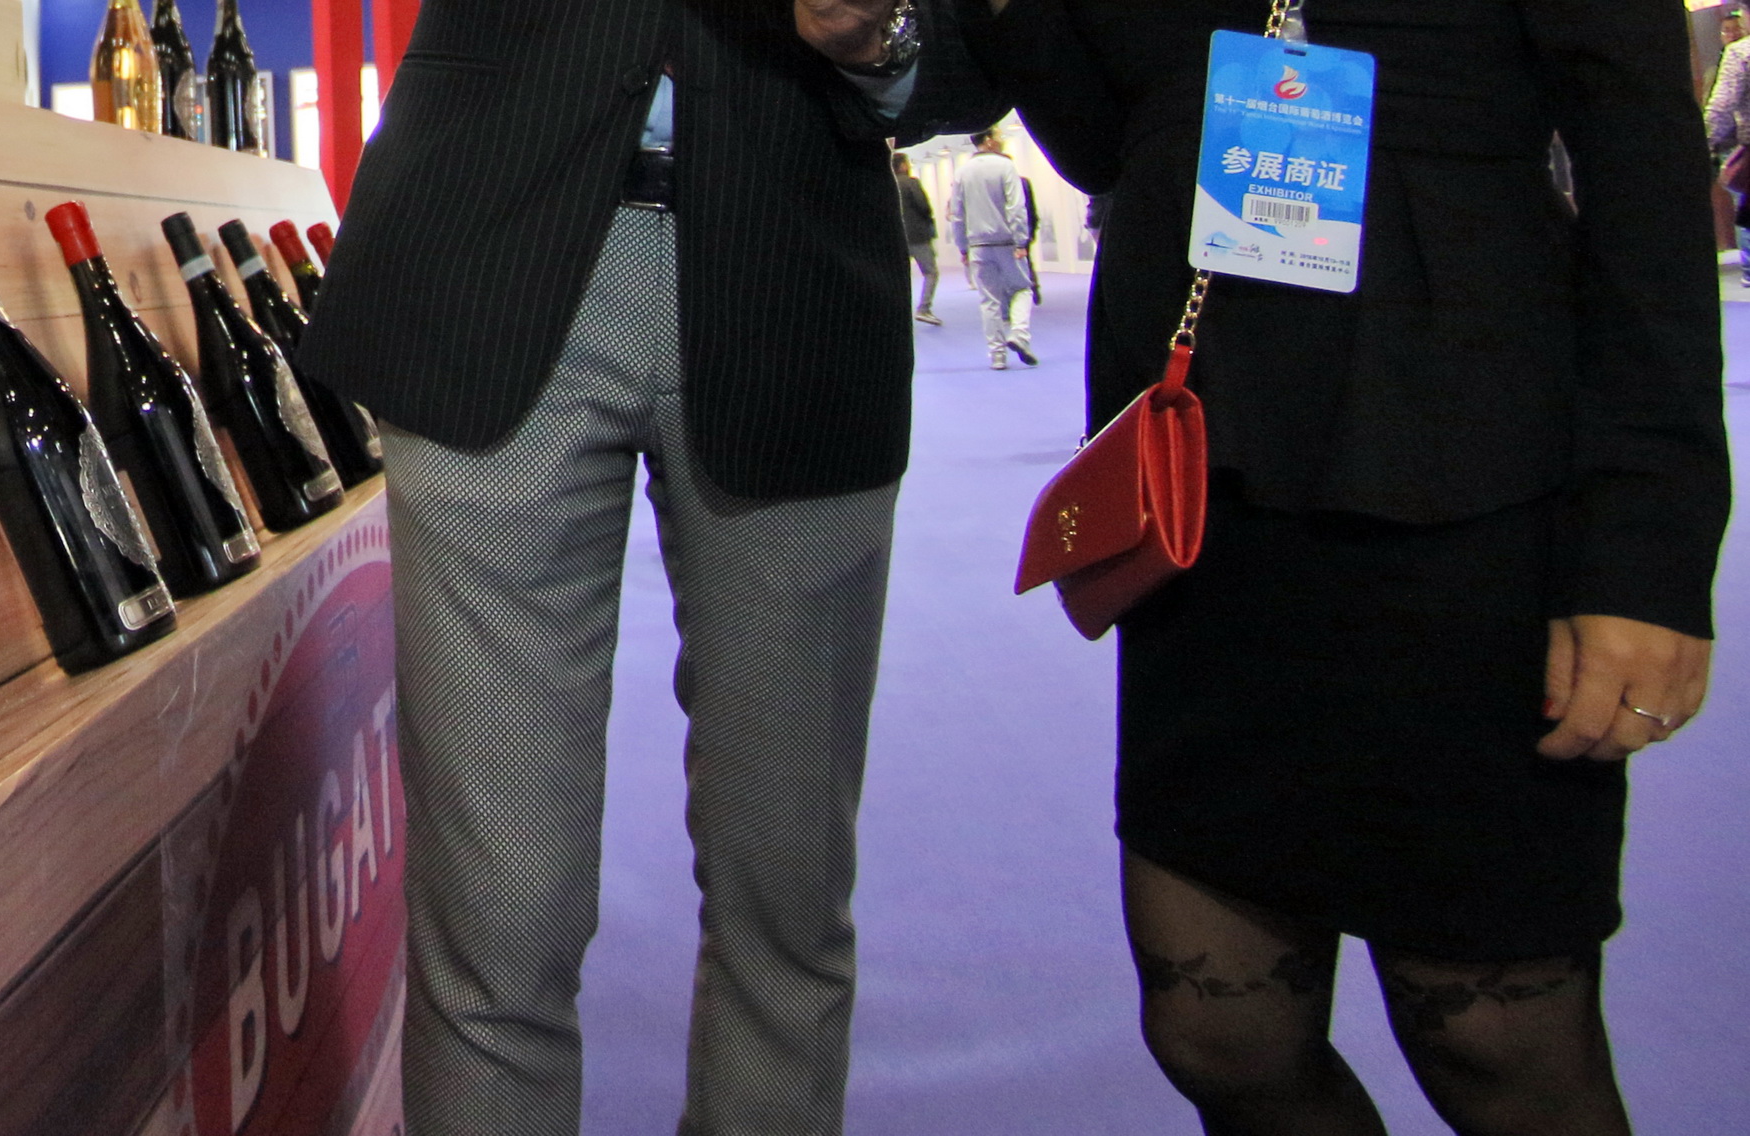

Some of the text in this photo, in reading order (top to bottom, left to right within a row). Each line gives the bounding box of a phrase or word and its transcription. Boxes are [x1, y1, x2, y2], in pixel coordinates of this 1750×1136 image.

[1221, 145, 1348, 191] 参展商证
[1249, 183, 1314, 202] EXHIBITOR
[227, 680, 396, 1131] BUGAT
